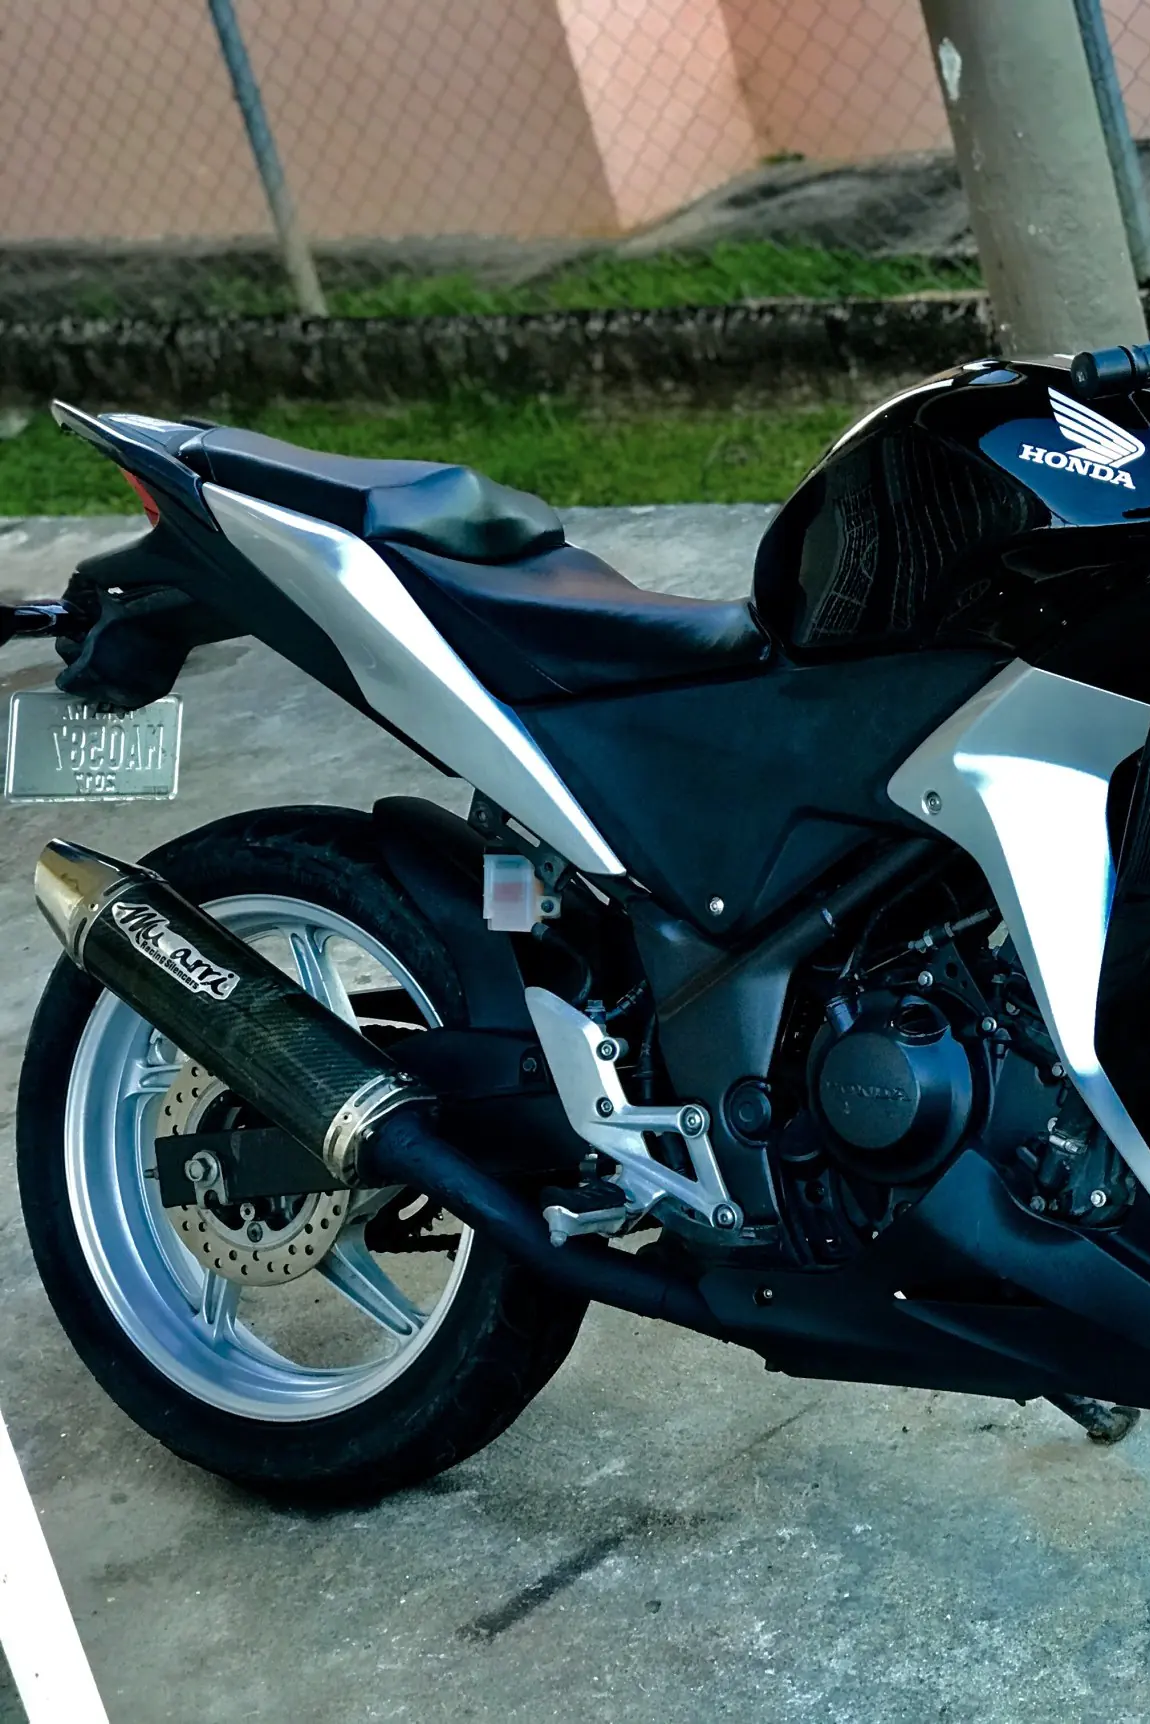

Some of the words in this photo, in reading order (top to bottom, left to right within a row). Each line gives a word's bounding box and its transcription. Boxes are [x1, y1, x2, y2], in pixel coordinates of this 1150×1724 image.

[1018, 443, 1136, 490] HONDA
[139, 940, 165, 965] Racing
[164, 957, 200, 990] Silencers
